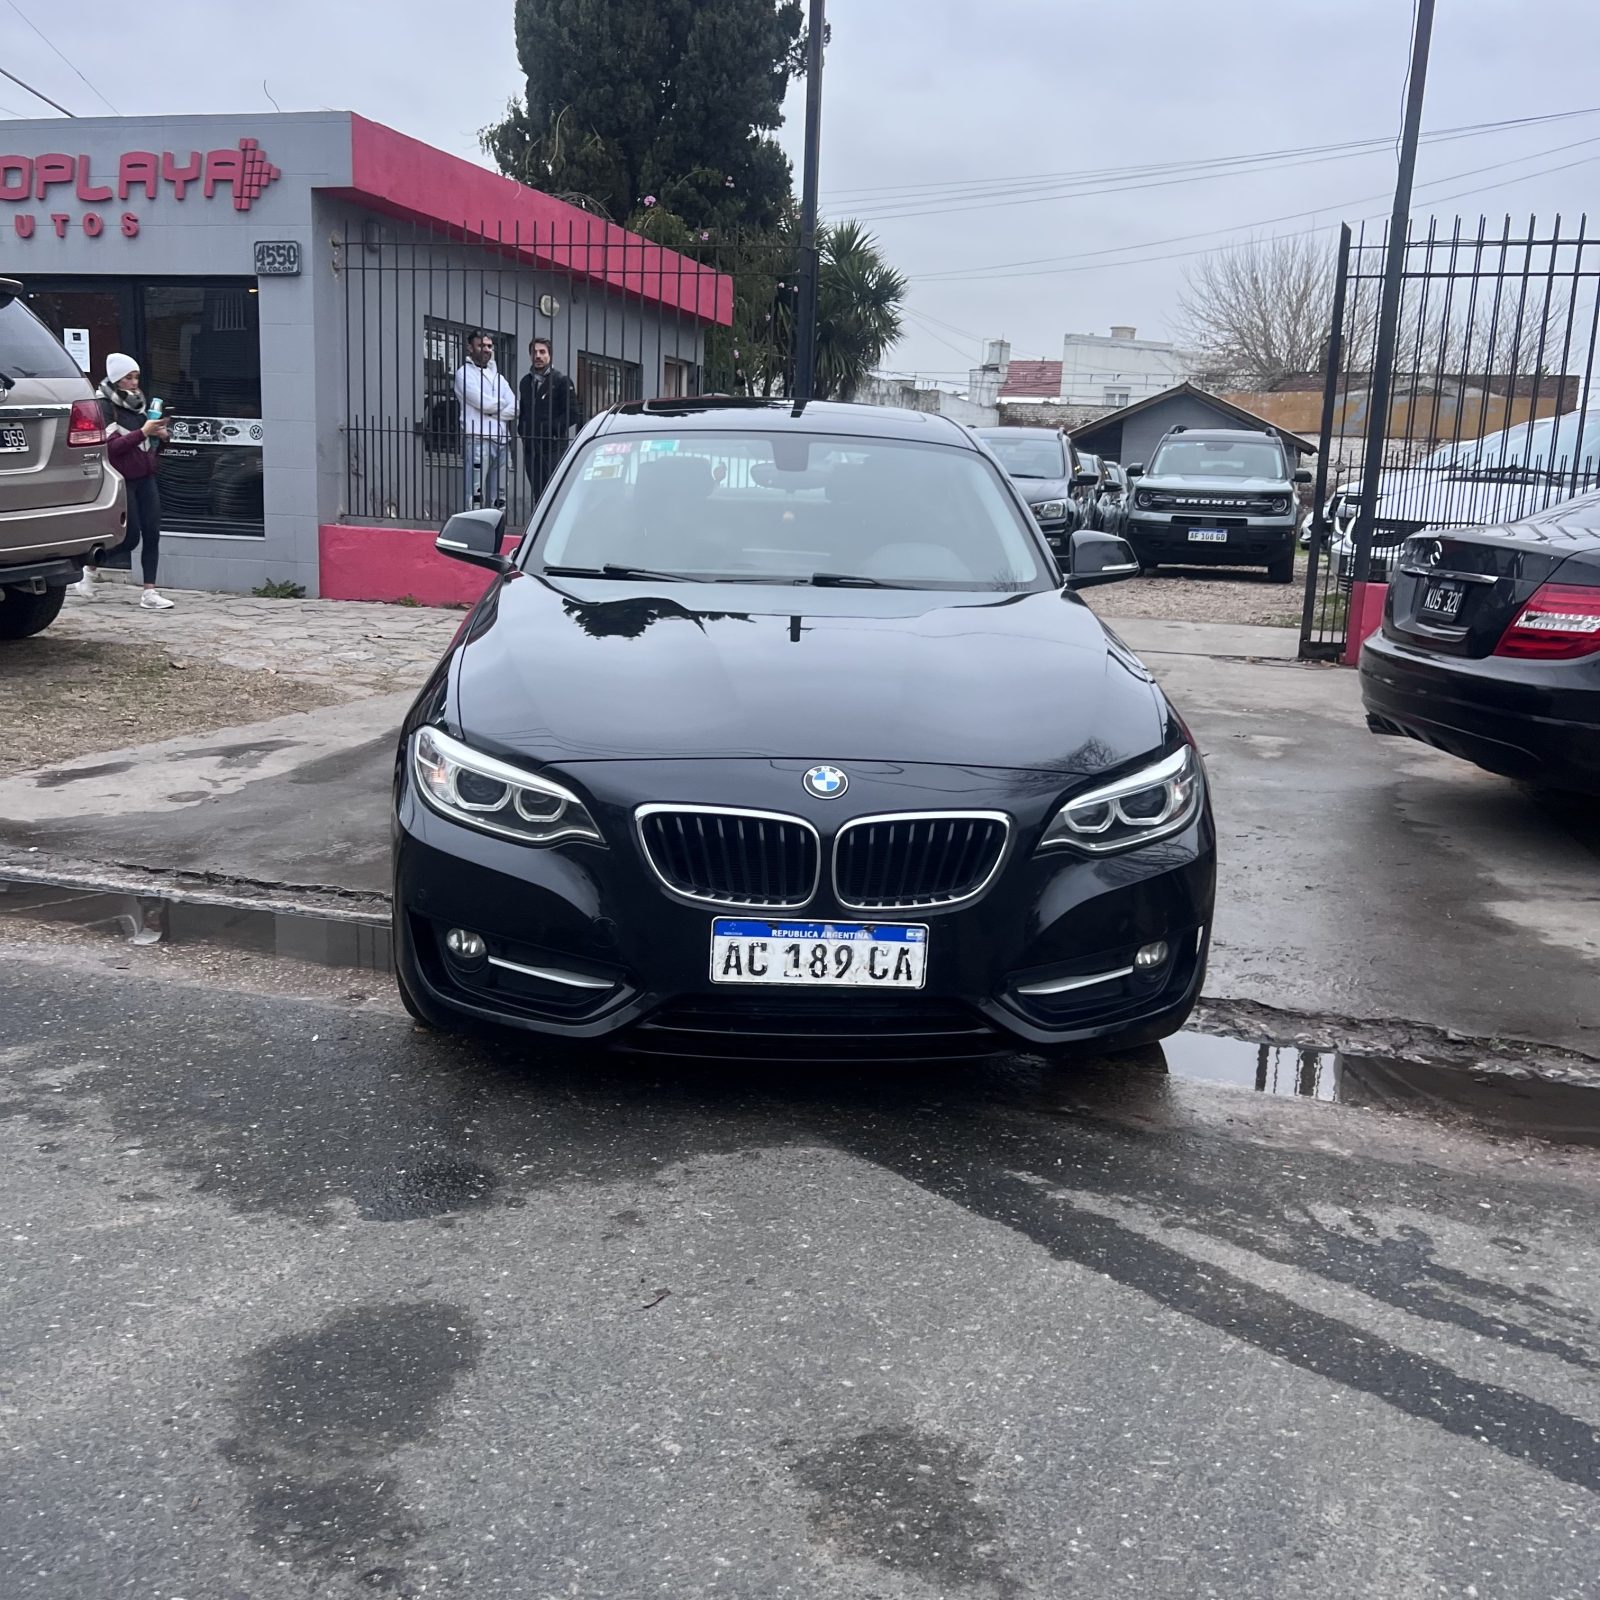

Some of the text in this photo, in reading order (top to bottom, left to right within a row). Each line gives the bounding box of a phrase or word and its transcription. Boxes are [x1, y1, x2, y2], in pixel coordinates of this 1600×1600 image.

[256, 244, 296, 266] 4550
[3, 430, 26, 447] 969
[1176, 498, 1247, 506] BRONCO
[1424, 588, 1463, 613] KUS 320
[771, 929, 869, 940] REPUBLICA ARGENTINA
[722, 942, 913, 981] AC 189 CA
